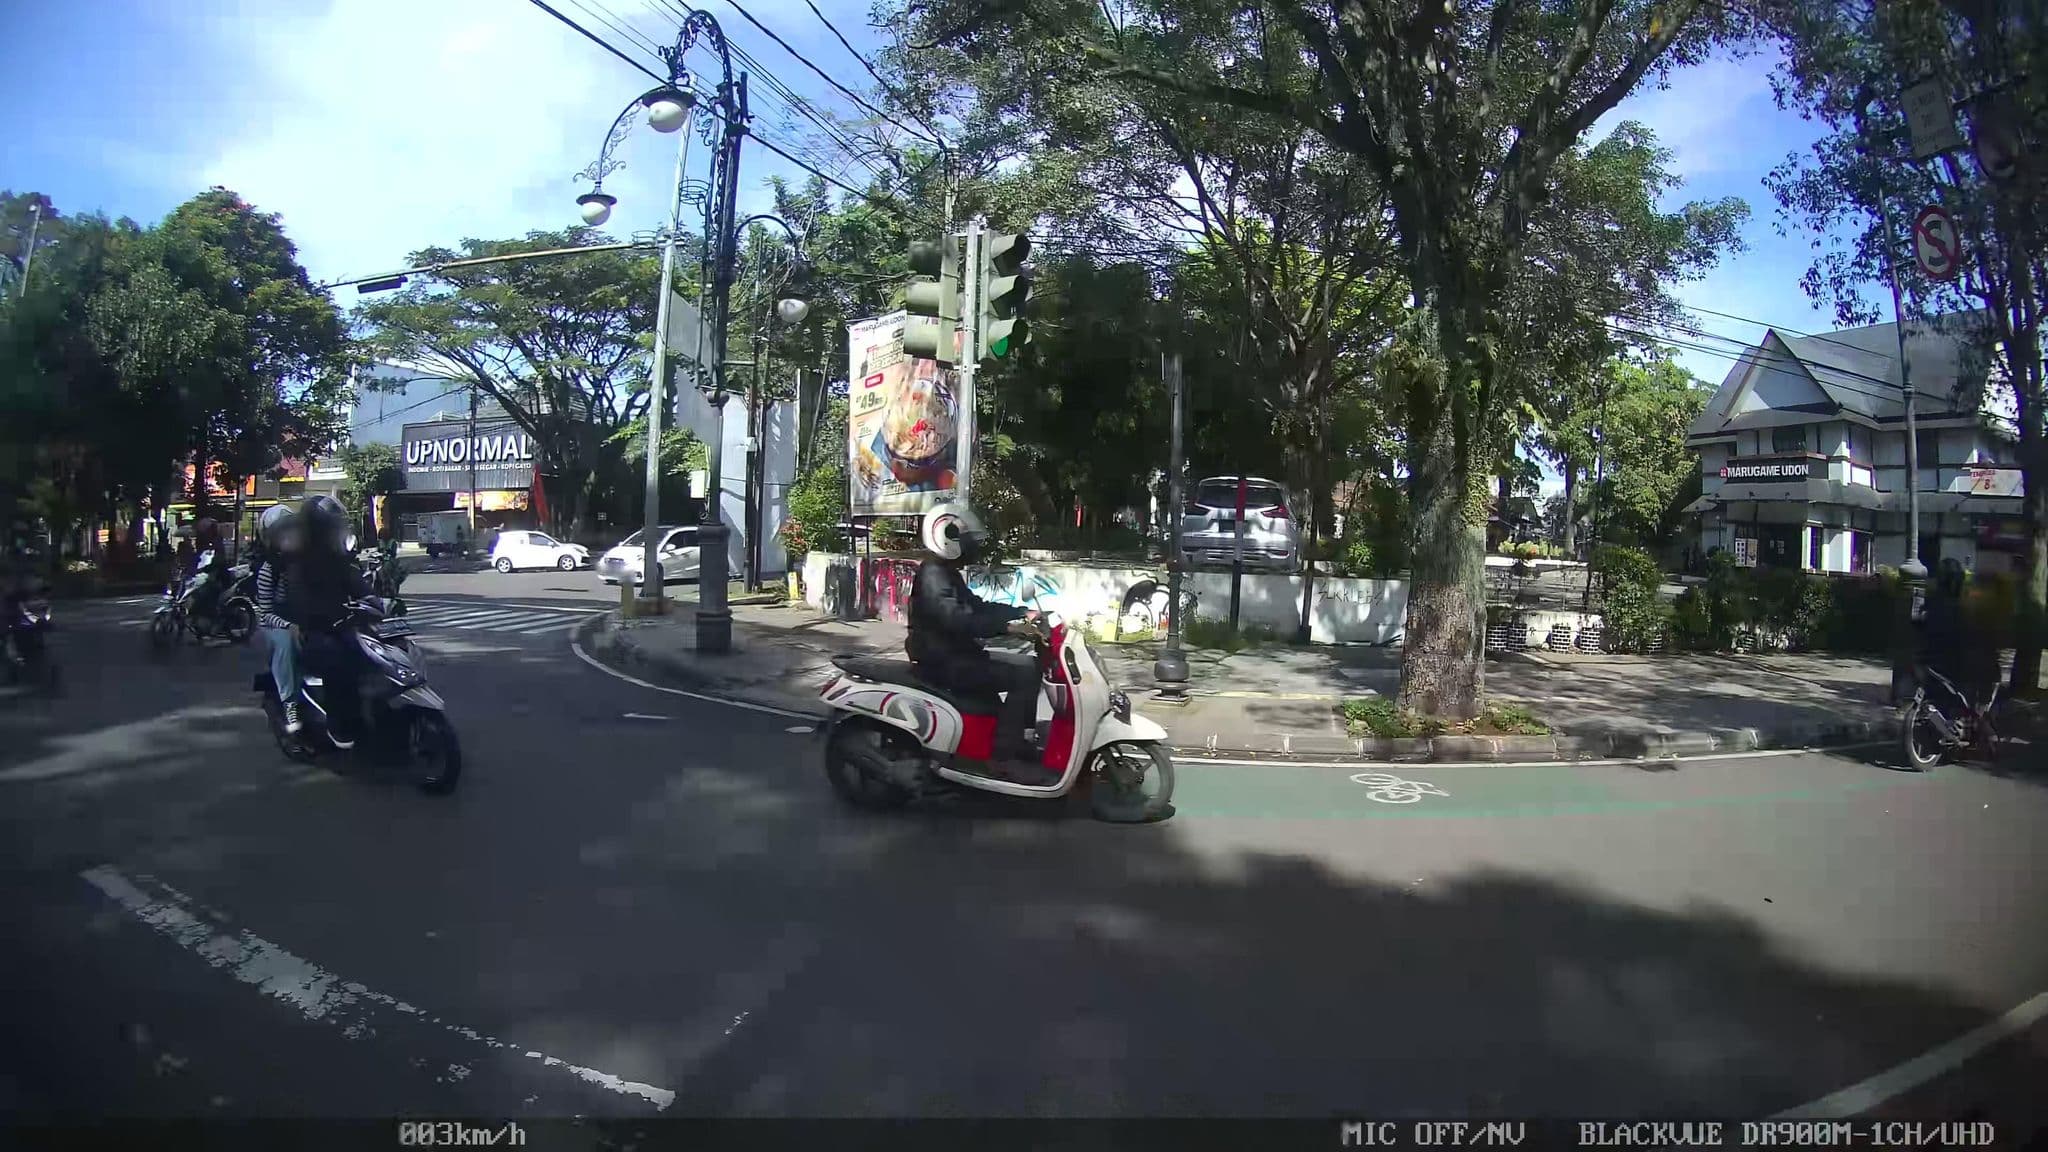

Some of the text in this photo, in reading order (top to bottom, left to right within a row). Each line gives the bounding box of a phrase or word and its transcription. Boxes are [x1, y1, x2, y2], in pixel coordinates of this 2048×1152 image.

[406, 434, 533, 464] UPNORMAL
[1727, 464, 1809, 478] MARUGAME UDON
